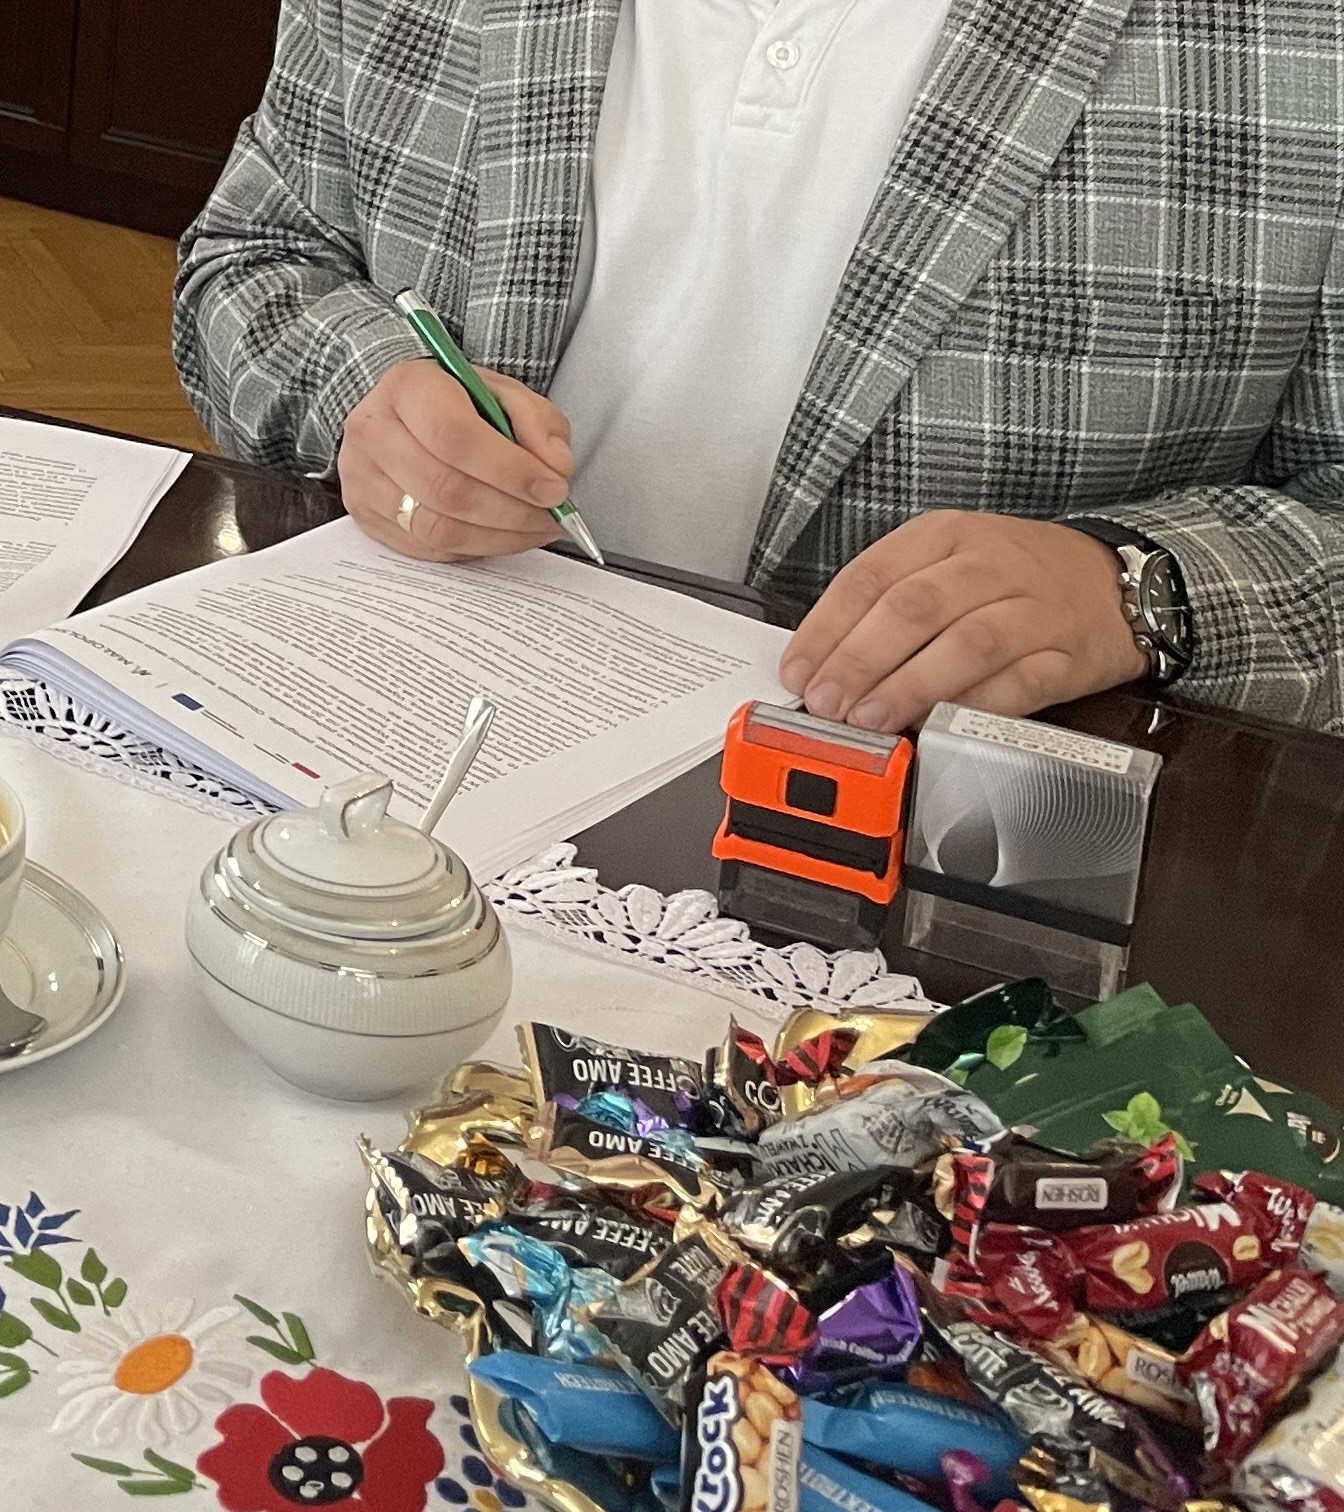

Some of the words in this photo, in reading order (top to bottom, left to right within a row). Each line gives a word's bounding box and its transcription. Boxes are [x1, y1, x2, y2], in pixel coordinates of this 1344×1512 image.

[572, 1058, 621, 1084] AMO
[589, 1129, 642, 1154] AMO
[413, 1192, 457, 1218] AMO
[1042, 1184, 1100, 1202] ROSHEN
[647, 1327, 700, 1379] AMO
